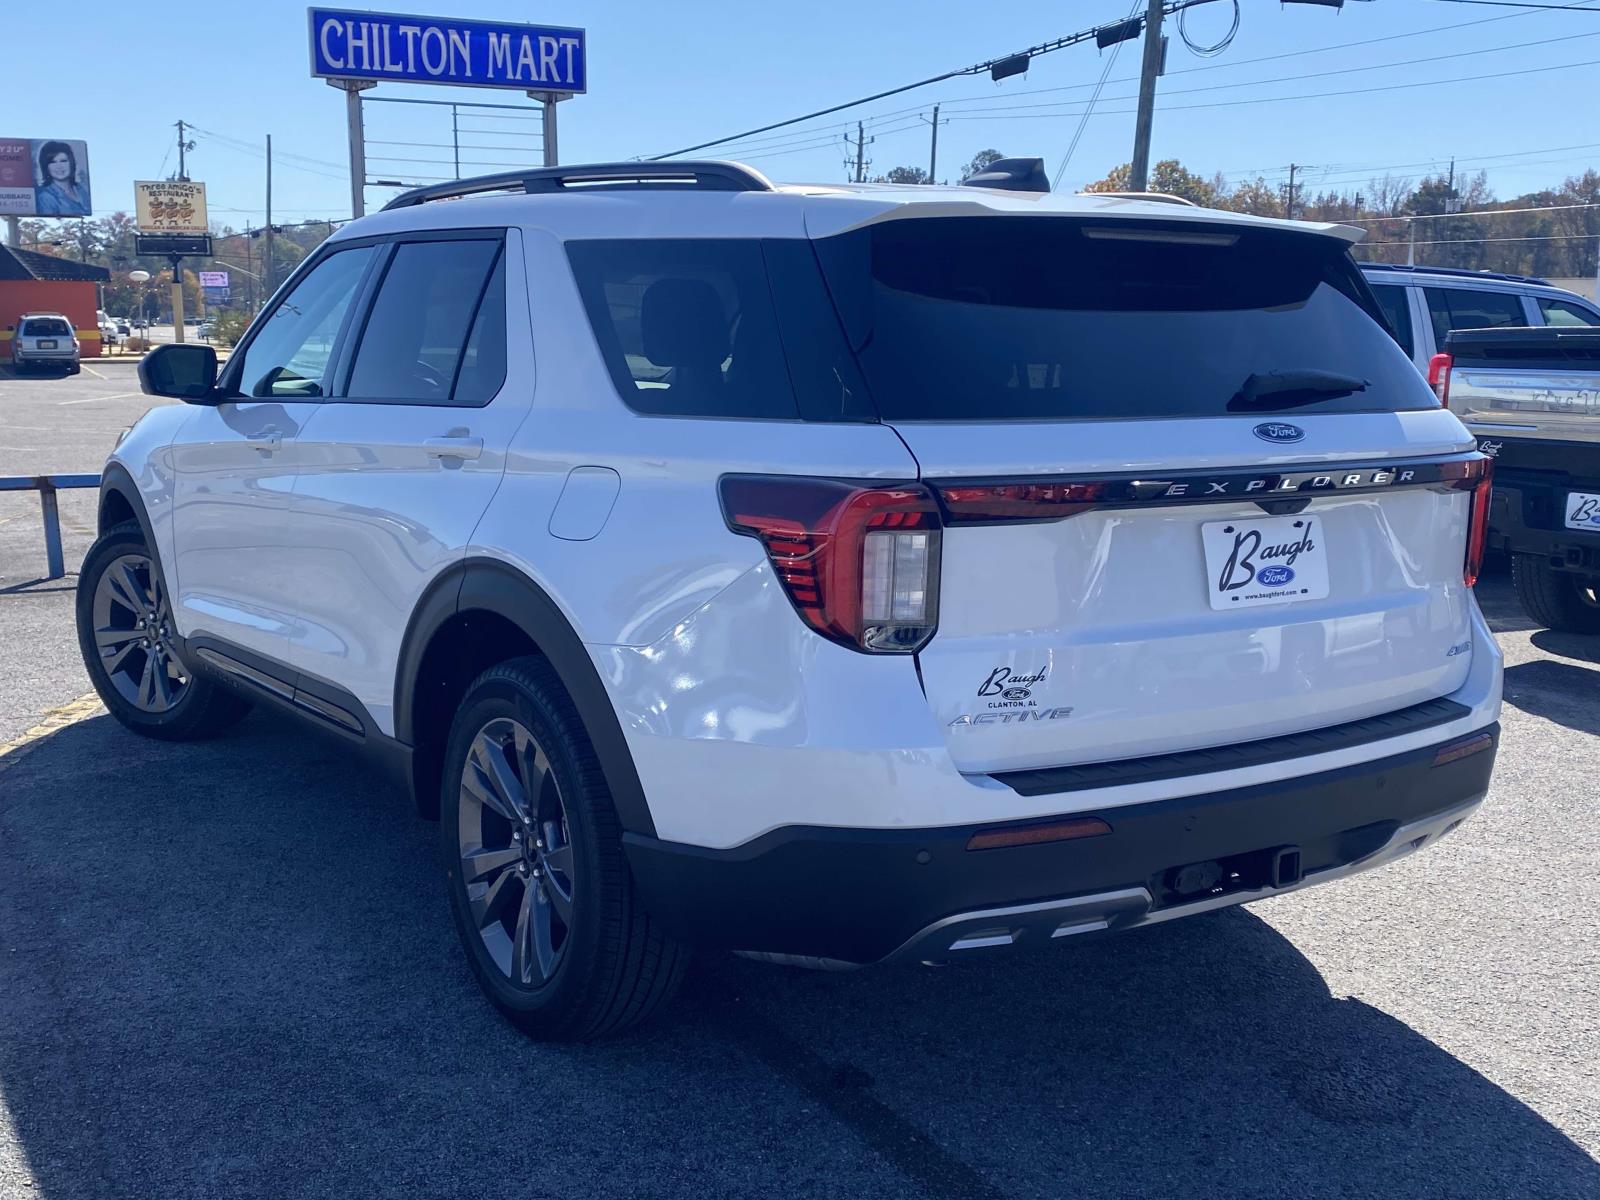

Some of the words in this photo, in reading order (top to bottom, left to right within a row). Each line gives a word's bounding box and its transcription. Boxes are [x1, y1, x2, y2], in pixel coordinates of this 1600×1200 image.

[320, 18, 472, 77] CHILTON
[487, 32, 579, 83] MART
[139, 183, 166, 192] Three
[149, 190, 195, 199] RESTAURANT
[1165, 468, 1416, 497] EXPLORER
[1218, 521, 1314, 592] Baugh
[1244, 590, 1297, 600] www.baughford.com
[977, 665, 1047, 697] Baugh
[988, 701, 1026, 709] CLANTON,
[947, 706, 1074, 727] ACTIVE
